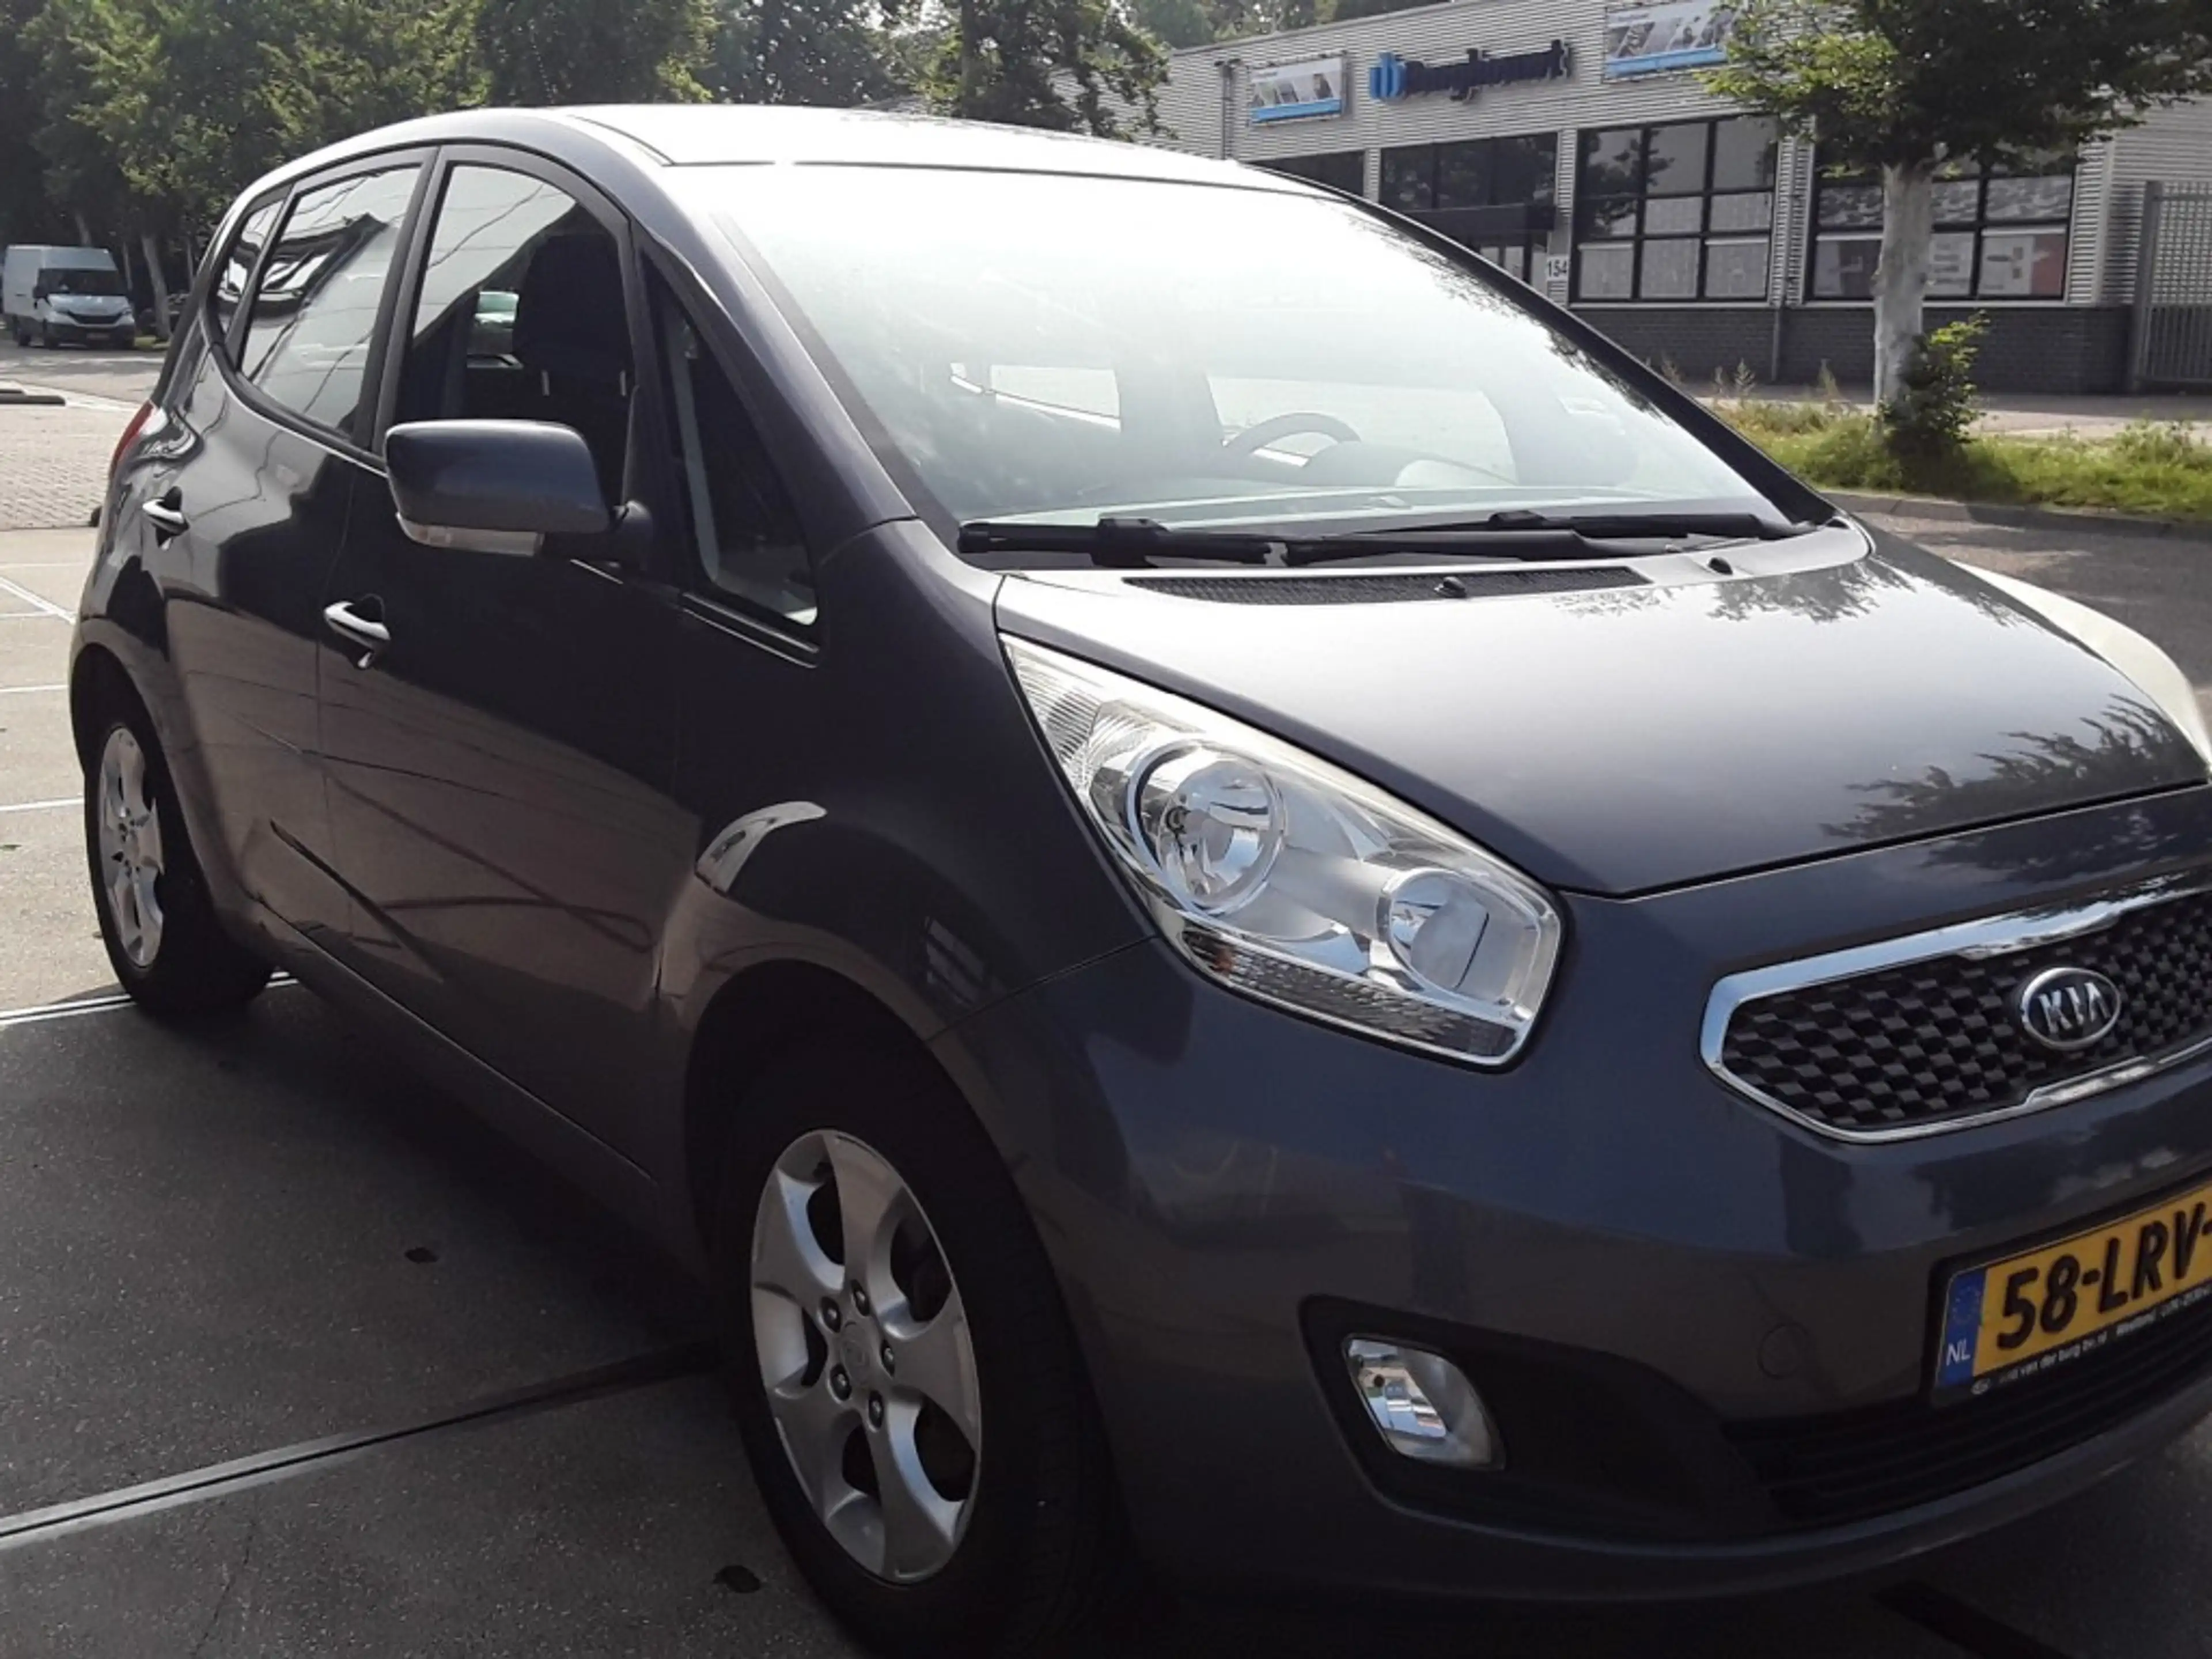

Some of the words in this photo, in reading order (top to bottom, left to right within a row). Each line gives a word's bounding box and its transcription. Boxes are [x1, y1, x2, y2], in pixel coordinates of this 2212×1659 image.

[1546, 259, 1567, 277] 154
[2037, 982, 2112, 1035] KIA
[1946, 1338, 1971, 1366] NL
